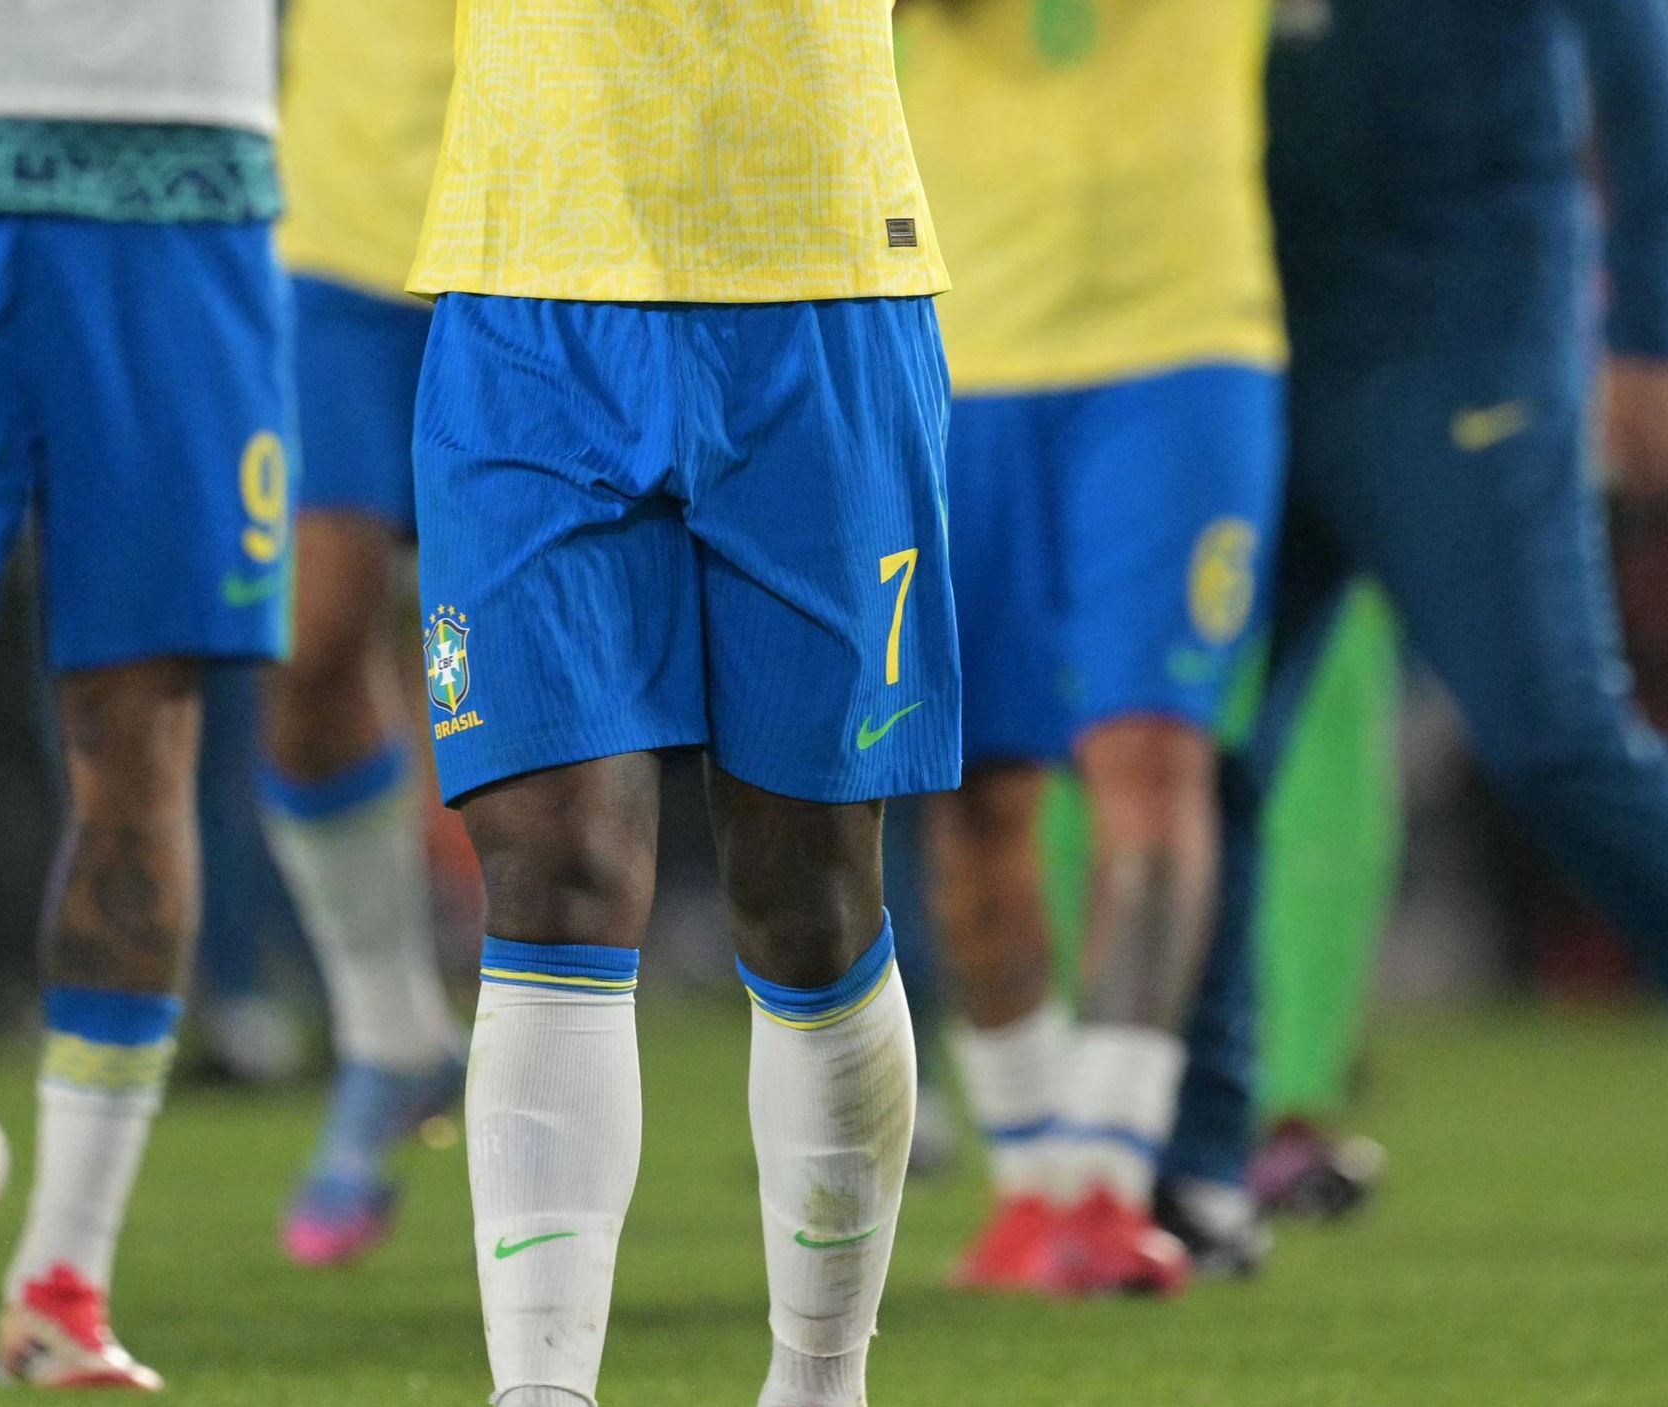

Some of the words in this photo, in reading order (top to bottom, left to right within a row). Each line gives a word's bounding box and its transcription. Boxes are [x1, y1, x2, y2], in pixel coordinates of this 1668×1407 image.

[239, 429, 288, 564] 9
[880, 548, 919, 685] 7
[438, 656, 454, 670] CBF
[434, 710, 484, 740] BRASIL
